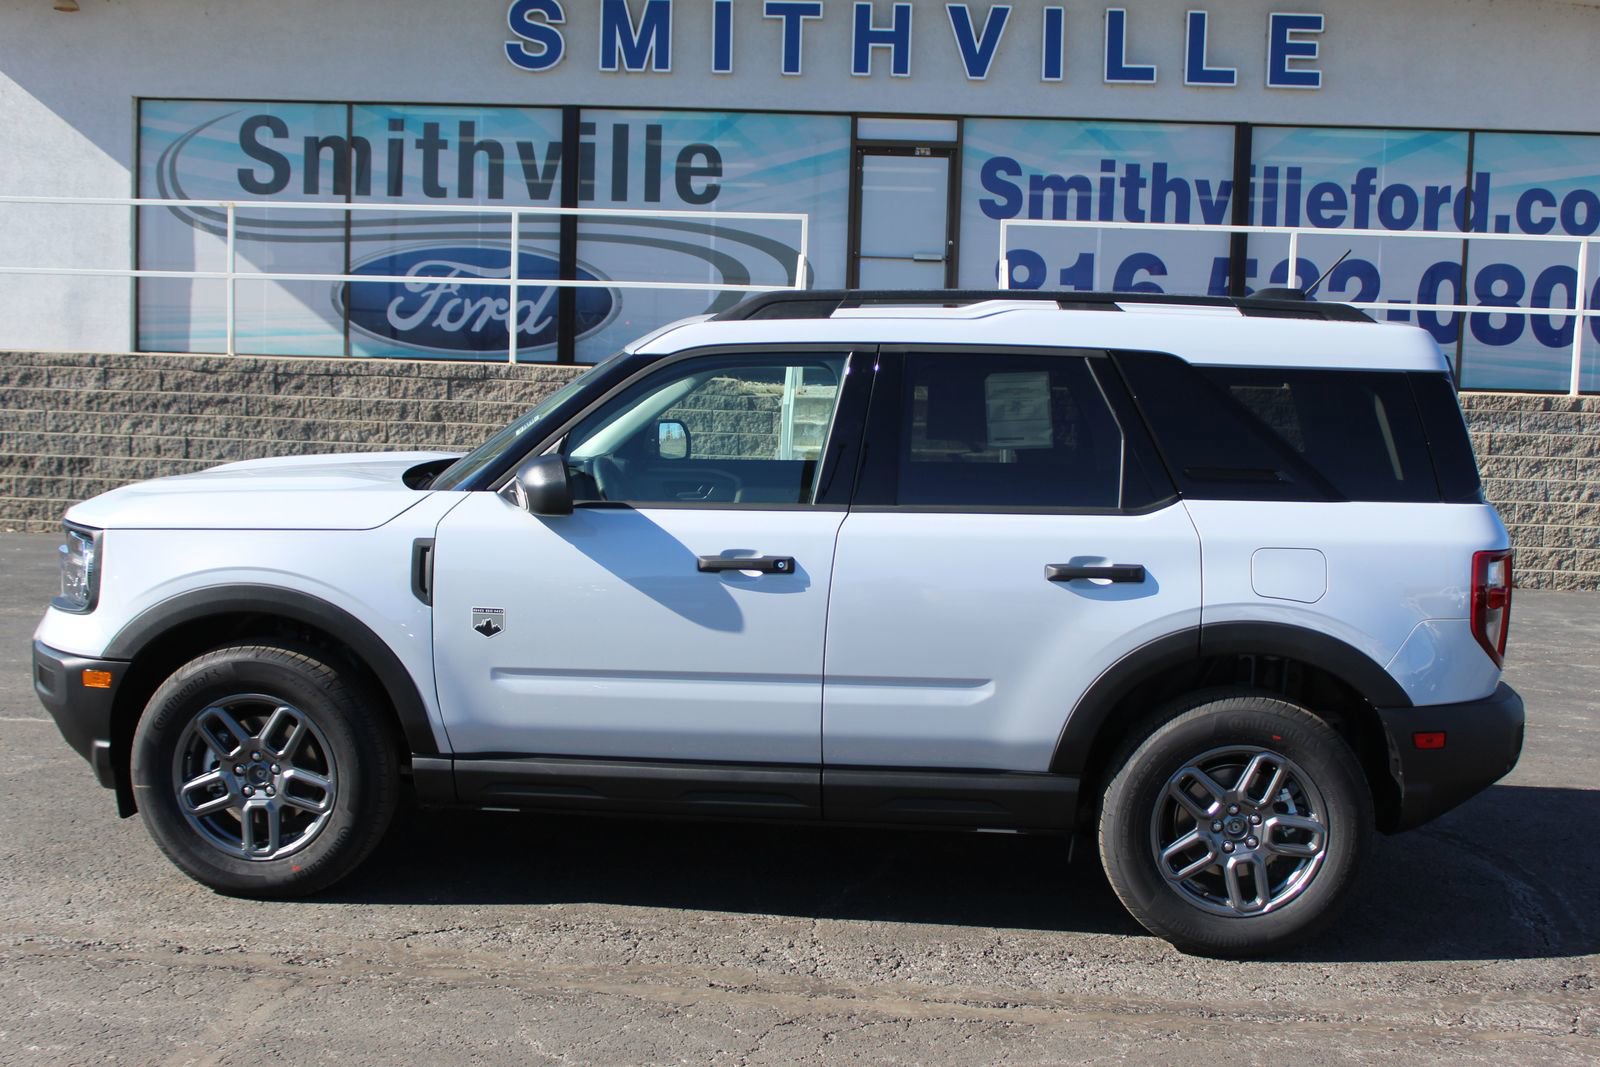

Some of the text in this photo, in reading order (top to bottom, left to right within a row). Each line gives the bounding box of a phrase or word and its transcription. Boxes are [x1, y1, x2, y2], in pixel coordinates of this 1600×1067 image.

[504, 0, 1324, 88] SMITHVILLE
[237, 114, 723, 206] Smithville
[387, 260, 558, 335] Ford
